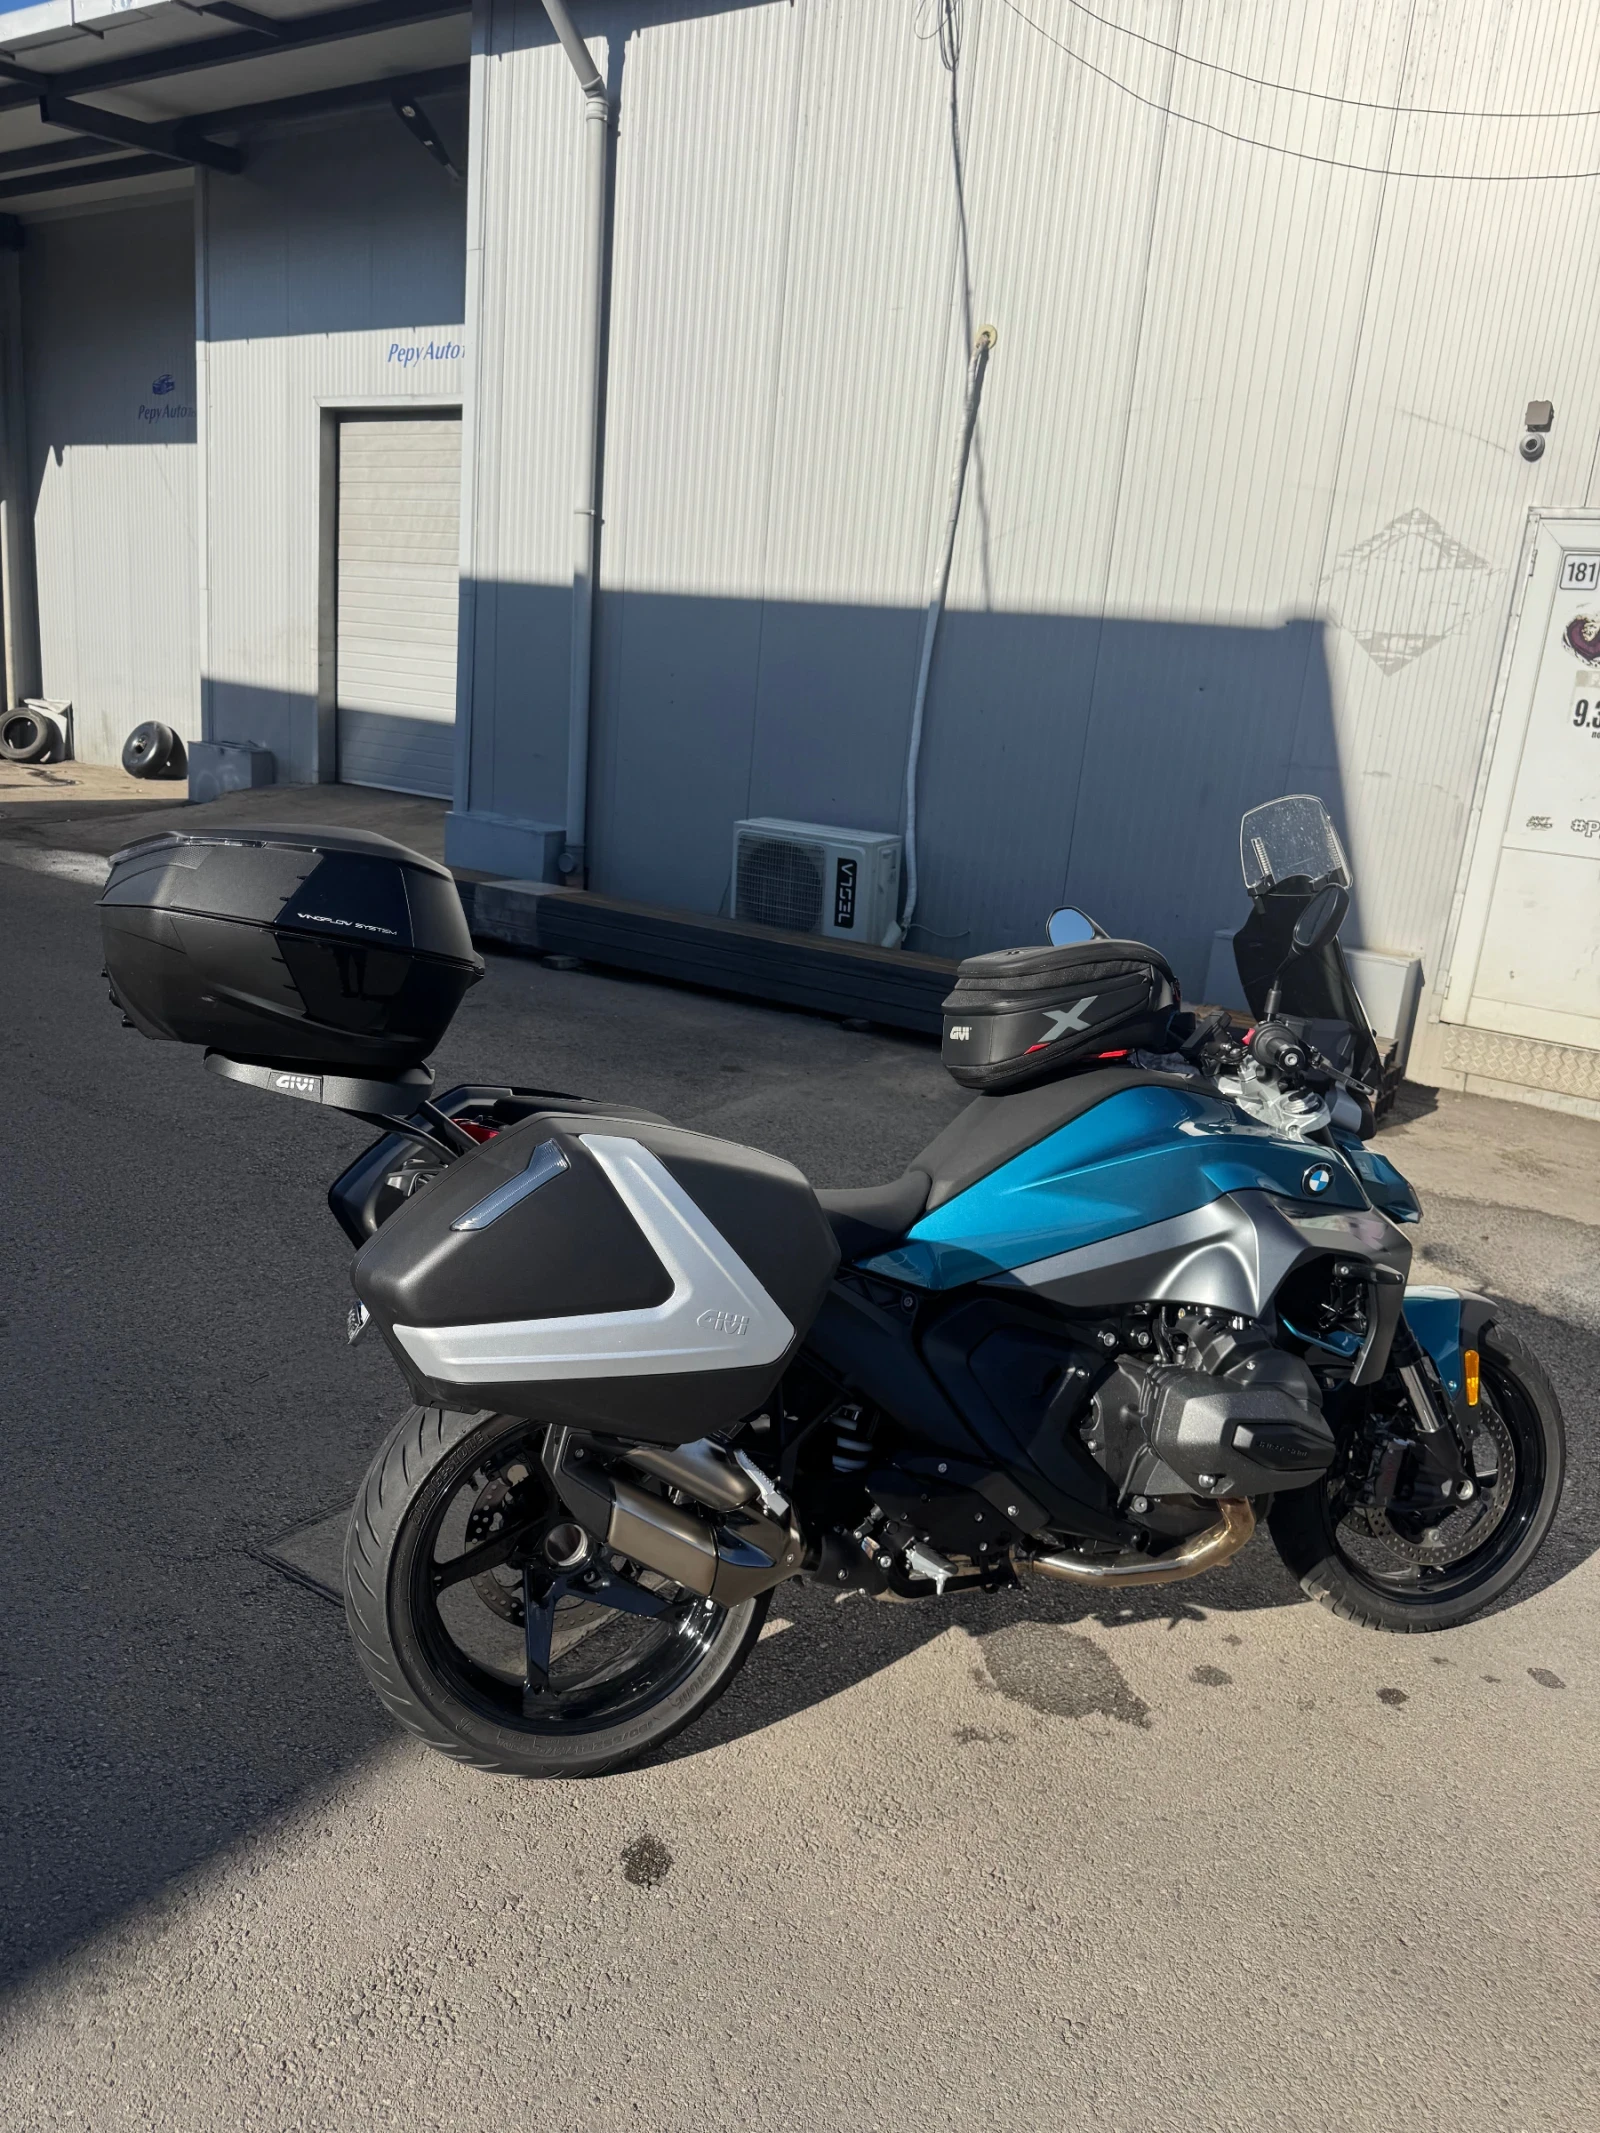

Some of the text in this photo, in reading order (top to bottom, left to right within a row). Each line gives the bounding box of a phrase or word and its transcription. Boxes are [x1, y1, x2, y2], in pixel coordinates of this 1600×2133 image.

[1567, 562, 1597, 582] 181
[838, 863, 854, 924] TESLA
[354, 922, 397, 936] SYSTEM
[950, 1026, 970, 1042] GIVI
[275, 1074, 315, 1092] GIVI
[696, 1308, 750, 1336] GIVI
[408, 1430, 485, 1524] BRIDGESTONE
